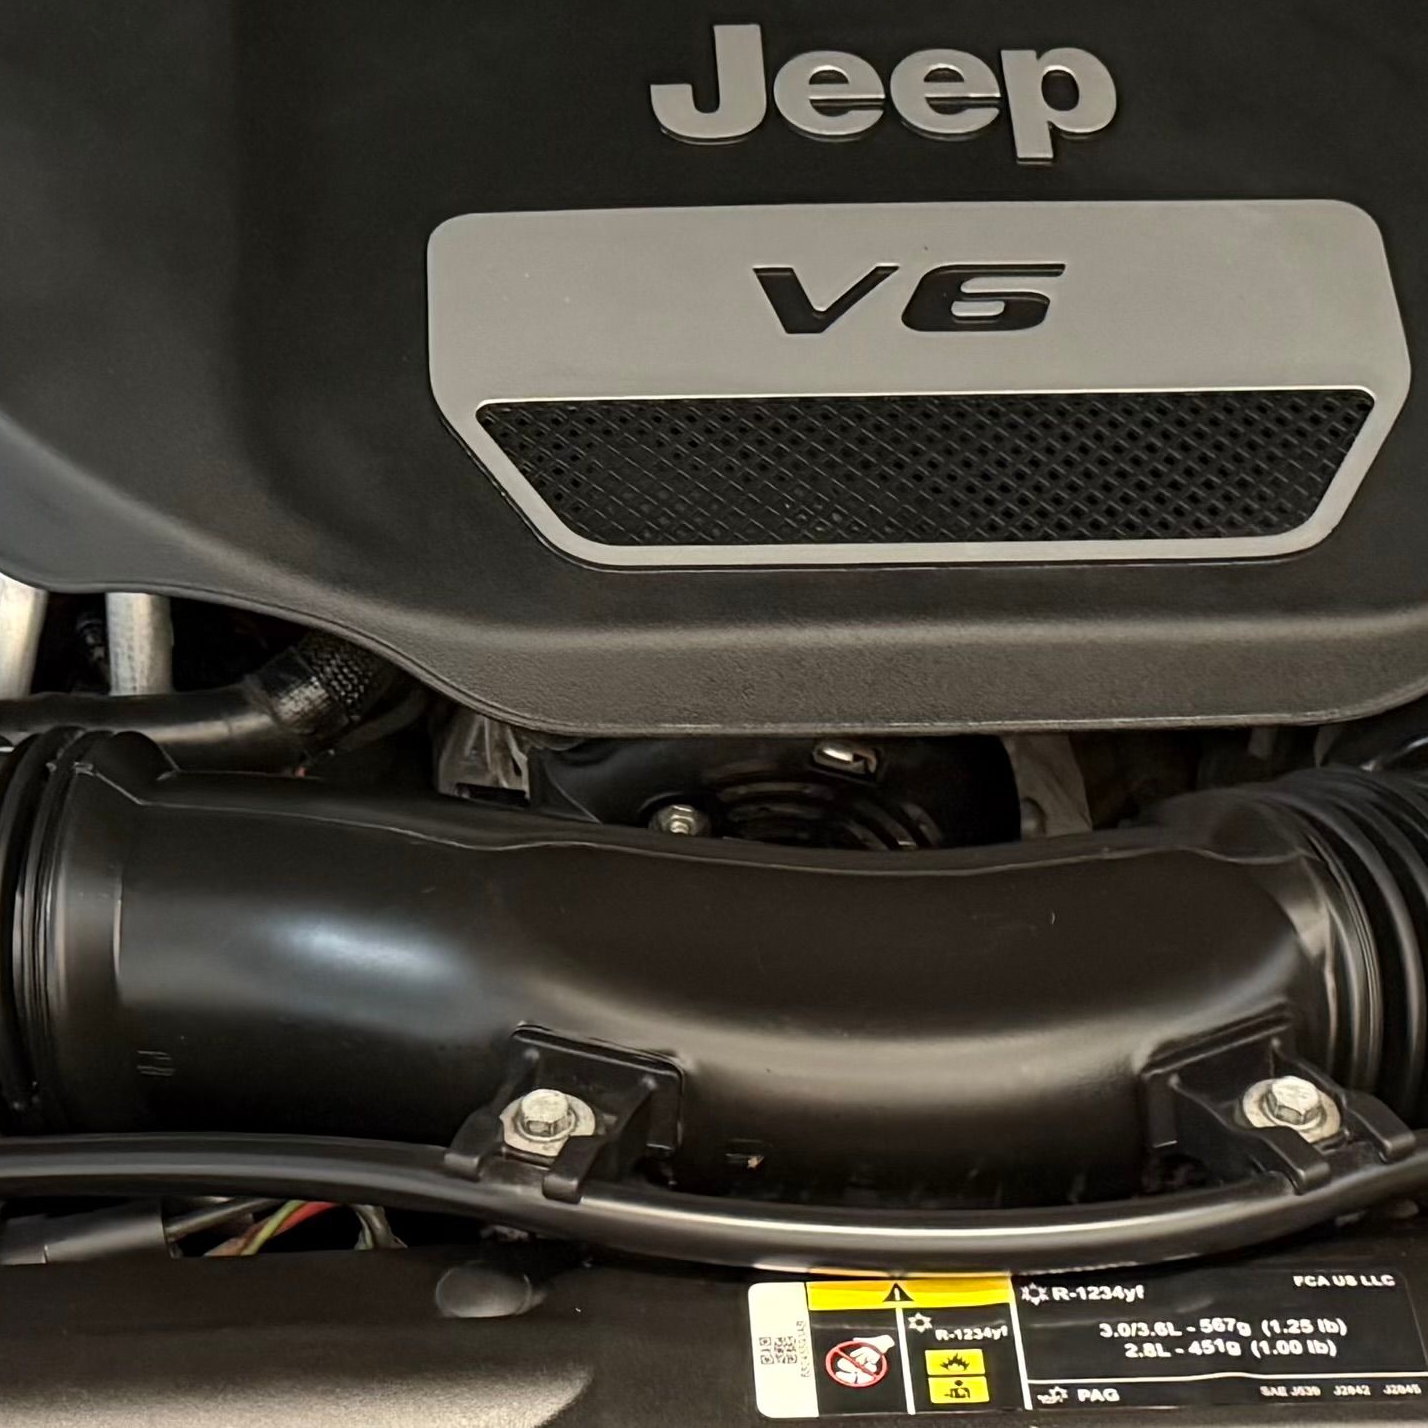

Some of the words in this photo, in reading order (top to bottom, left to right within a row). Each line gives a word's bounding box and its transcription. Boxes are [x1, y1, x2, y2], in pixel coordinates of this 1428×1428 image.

[649, 23, 1119, 165] Jeep
[752, 262, 1067, 335] V6
[1293, 1275, 1330, 1288] FCA
[1332, 1275, 1358, 1287] US
[1360, 1274, 1395, 1287] LLC
[1051, 1284, 1145, 1303] R-1234yf
[935, 1324, 1008, 1342] R-1234yf
[1099, 1322, 1182, 1338] 3.0/3.6L
[1199, 1317, 1252, 1337] 567g
[1261, 1318, 1314, 1337] (1.25
[1317, 1318, 1348, 1337] lb)
[1124, 1342, 1172, 1358] 2.8L
[1188, 1338, 1242, 1357] 451g
[1250, 1339, 1303, 1359] (1.00
[1306, 1338, 1337, 1357] lb)
[1077, 1388, 1120, 1402] PAG
[1259, 1385, 1289, 1397] SAE
